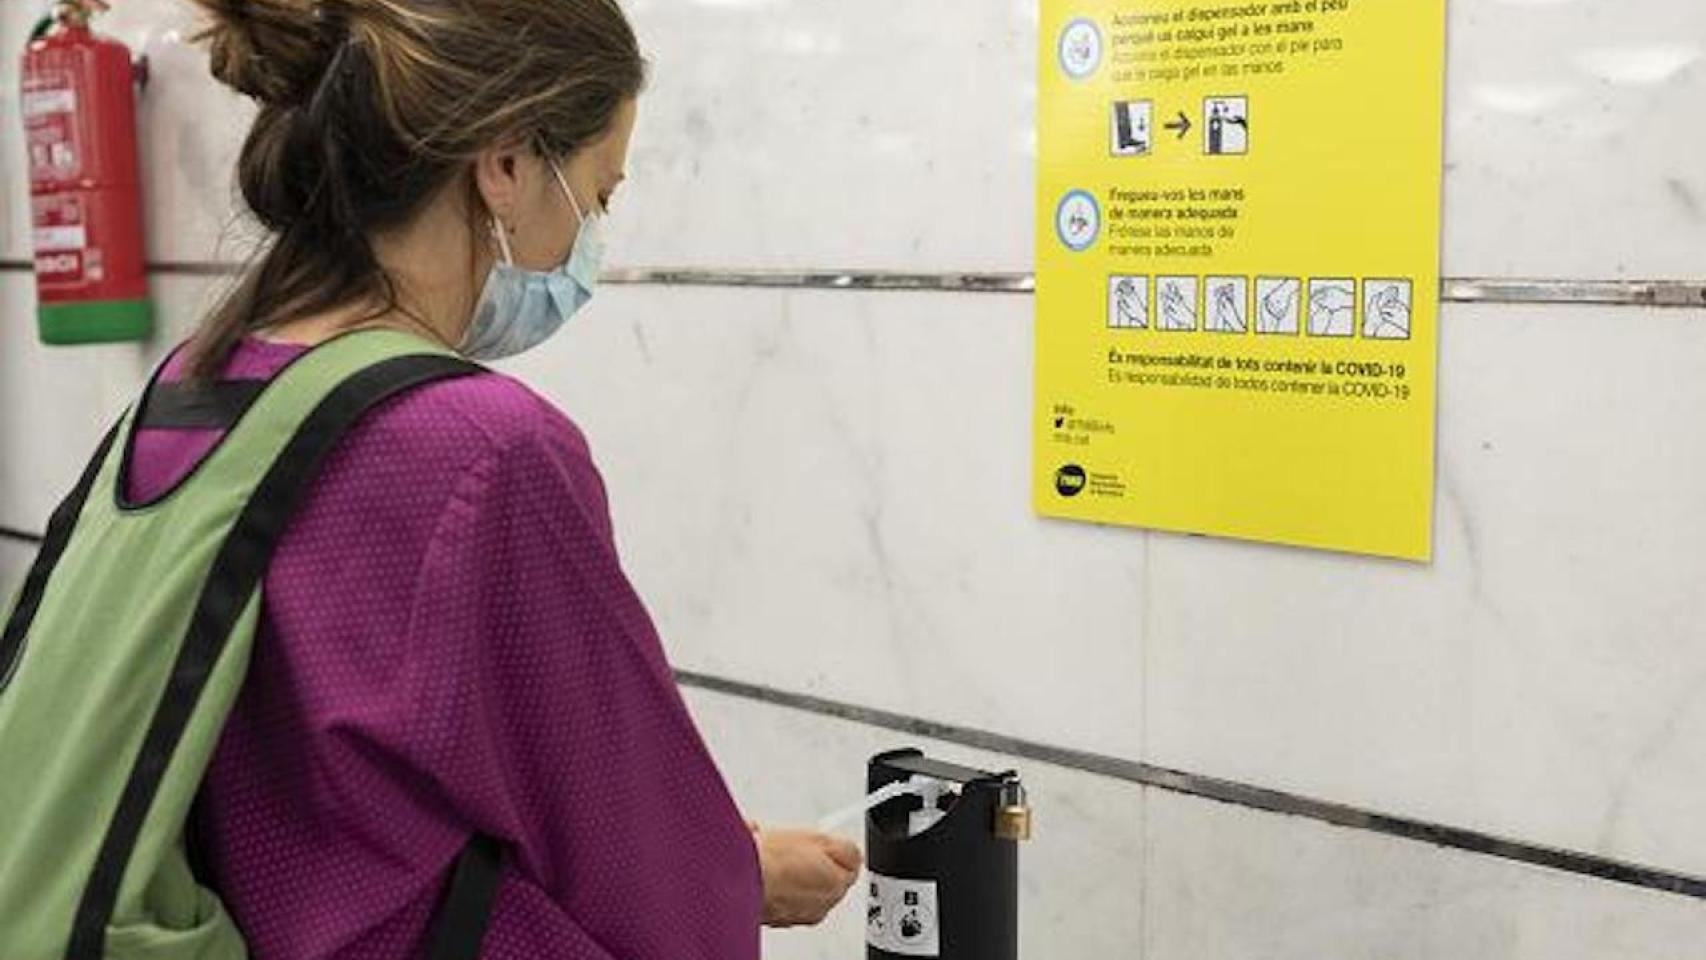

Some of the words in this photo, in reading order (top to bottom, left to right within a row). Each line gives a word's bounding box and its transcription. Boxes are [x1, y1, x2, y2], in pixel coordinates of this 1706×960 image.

[1216, 22, 1238, 41] gel
[1240, 24, 1250, 37] a
[1252, 20, 1272, 36] les
[1312, 37, 1343, 56] para
[1125, 353, 1214, 369] responsabilitat
[1216, 356, 1232, 369] de
[1236, 356, 1260, 371] tots
[1263, 359, 1318, 374] contenir
[1336, 361, 1406, 378] COVID-19
[1126, 371, 1212, 388] responsabilidad
[1233, 375, 1269, 392] todos
[1270, 378, 1325, 395] contener
[1342, 382, 1411, 400] COVID-19
